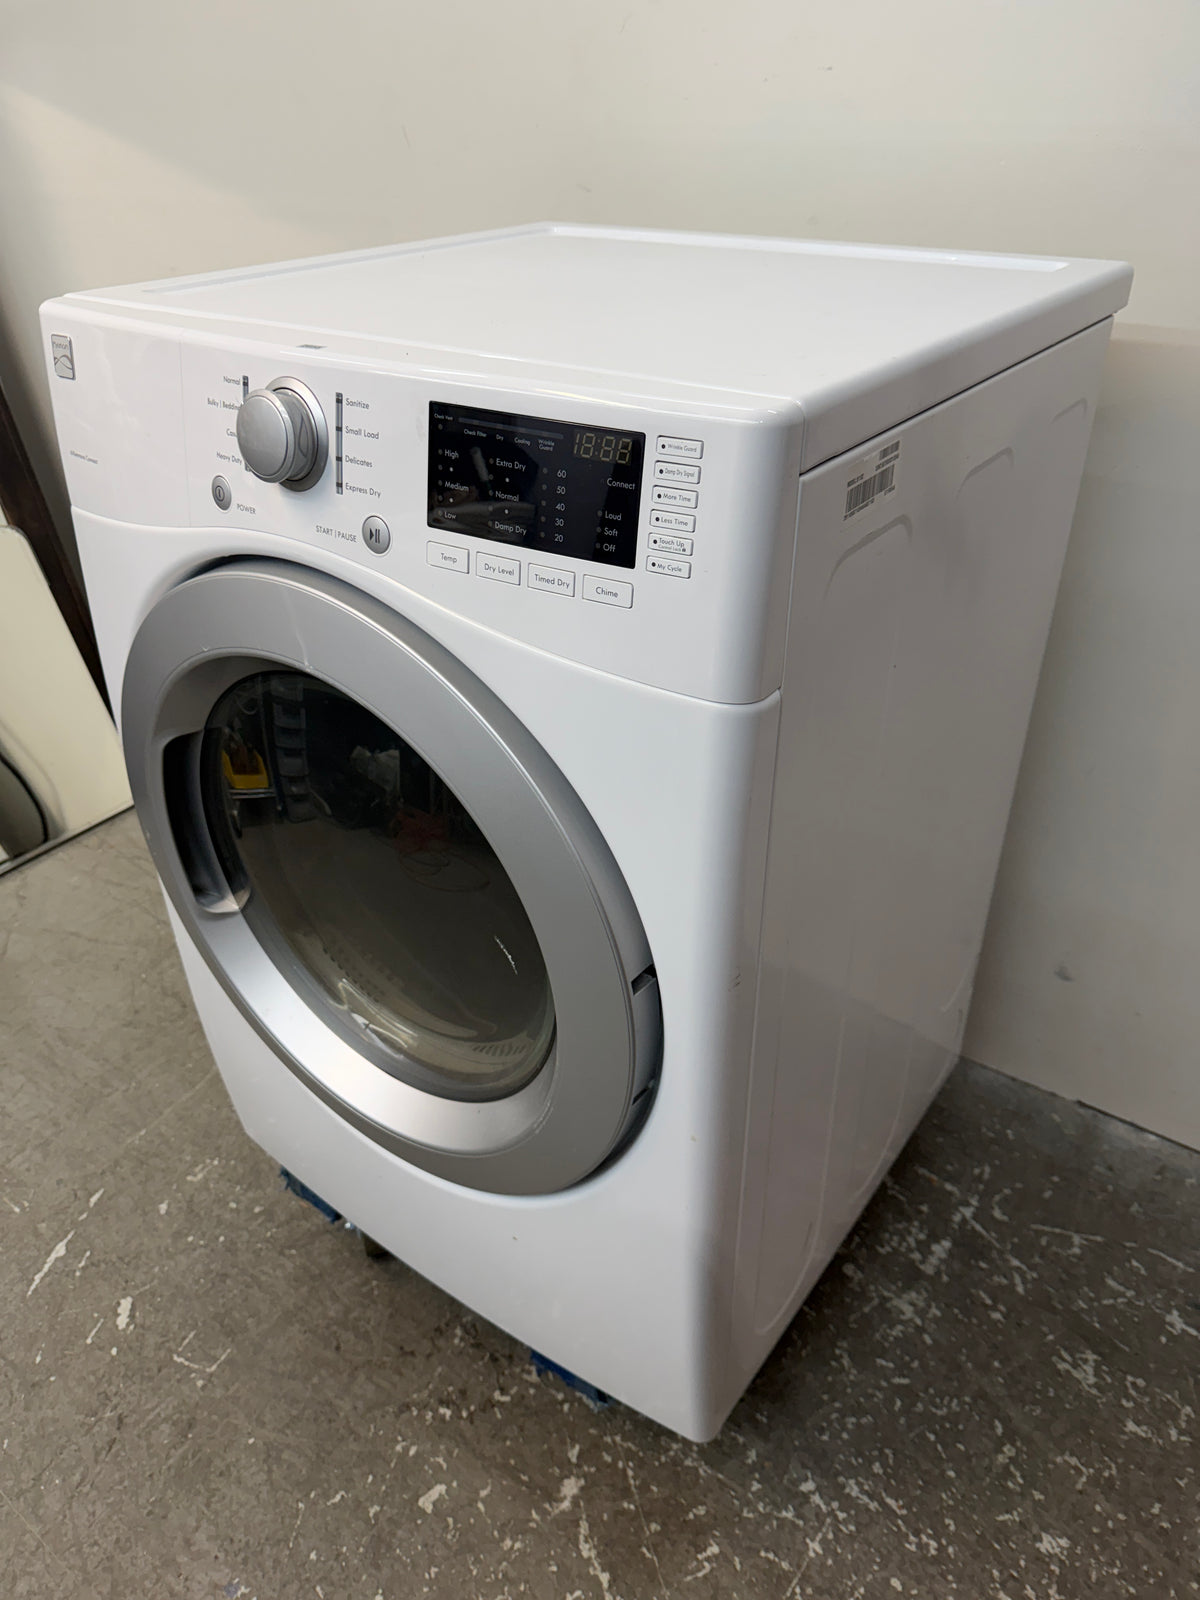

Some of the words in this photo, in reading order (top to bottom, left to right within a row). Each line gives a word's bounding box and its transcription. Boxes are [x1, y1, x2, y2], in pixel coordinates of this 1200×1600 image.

[345, 399, 370, 410] Sanitize
[345, 425, 363, 436] Small
[363, 428, 380, 439] Load
[216, 451, 231, 462] Heavy
[231, 455, 243, 466] Duty
[444, 449, 459, 460] High
[345, 455, 373, 468] Delicates
[495, 458, 513, 468] Extra
[514, 461, 527, 472] Dry
[556, 469, 567, 479] 60
[444, 480, 469, 492] Medium
[606, 477, 636, 490] Connect
[345, 482, 368, 496] Express
[369, 486, 382, 498] Dry
[556, 486, 566, 495] 50
[495, 491, 520, 502] Normal
[663, 492, 678, 501] More
[678, 494, 692, 503] Time
[236, 503, 257, 515] POWER
[555, 502, 566, 511] 40
[444, 511, 457, 520] Low
[604, 510, 622, 521] Loud
[660, 515, 673, 525] Less
[674, 517, 689, 527] Time
[494, 521, 514, 533] Damp
[514, 525, 527, 536] Dry
[555, 518, 565, 527] 30
[315, 525, 335, 537] START
[337, 530, 358, 543] PAUSE
[554, 533, 564, 542] 20
[603, 527, 619, 537] Soft
[602, 543, 617, 552] Off
[658, 537, 675, 546] Touch
[675, 540, 686, 549] Up
[440, 552, 458, 564] Temp
[484, 563, 497, 574] Dry
[497, 566, 515, 577] Level
[656, 563, 666, 571] My
[666, 564, 683, 573] Cycle
[534, 574, 556, 586] Timed
[556, 578, 571, 590] Dry
[595, 586, 619, 599] Chime
